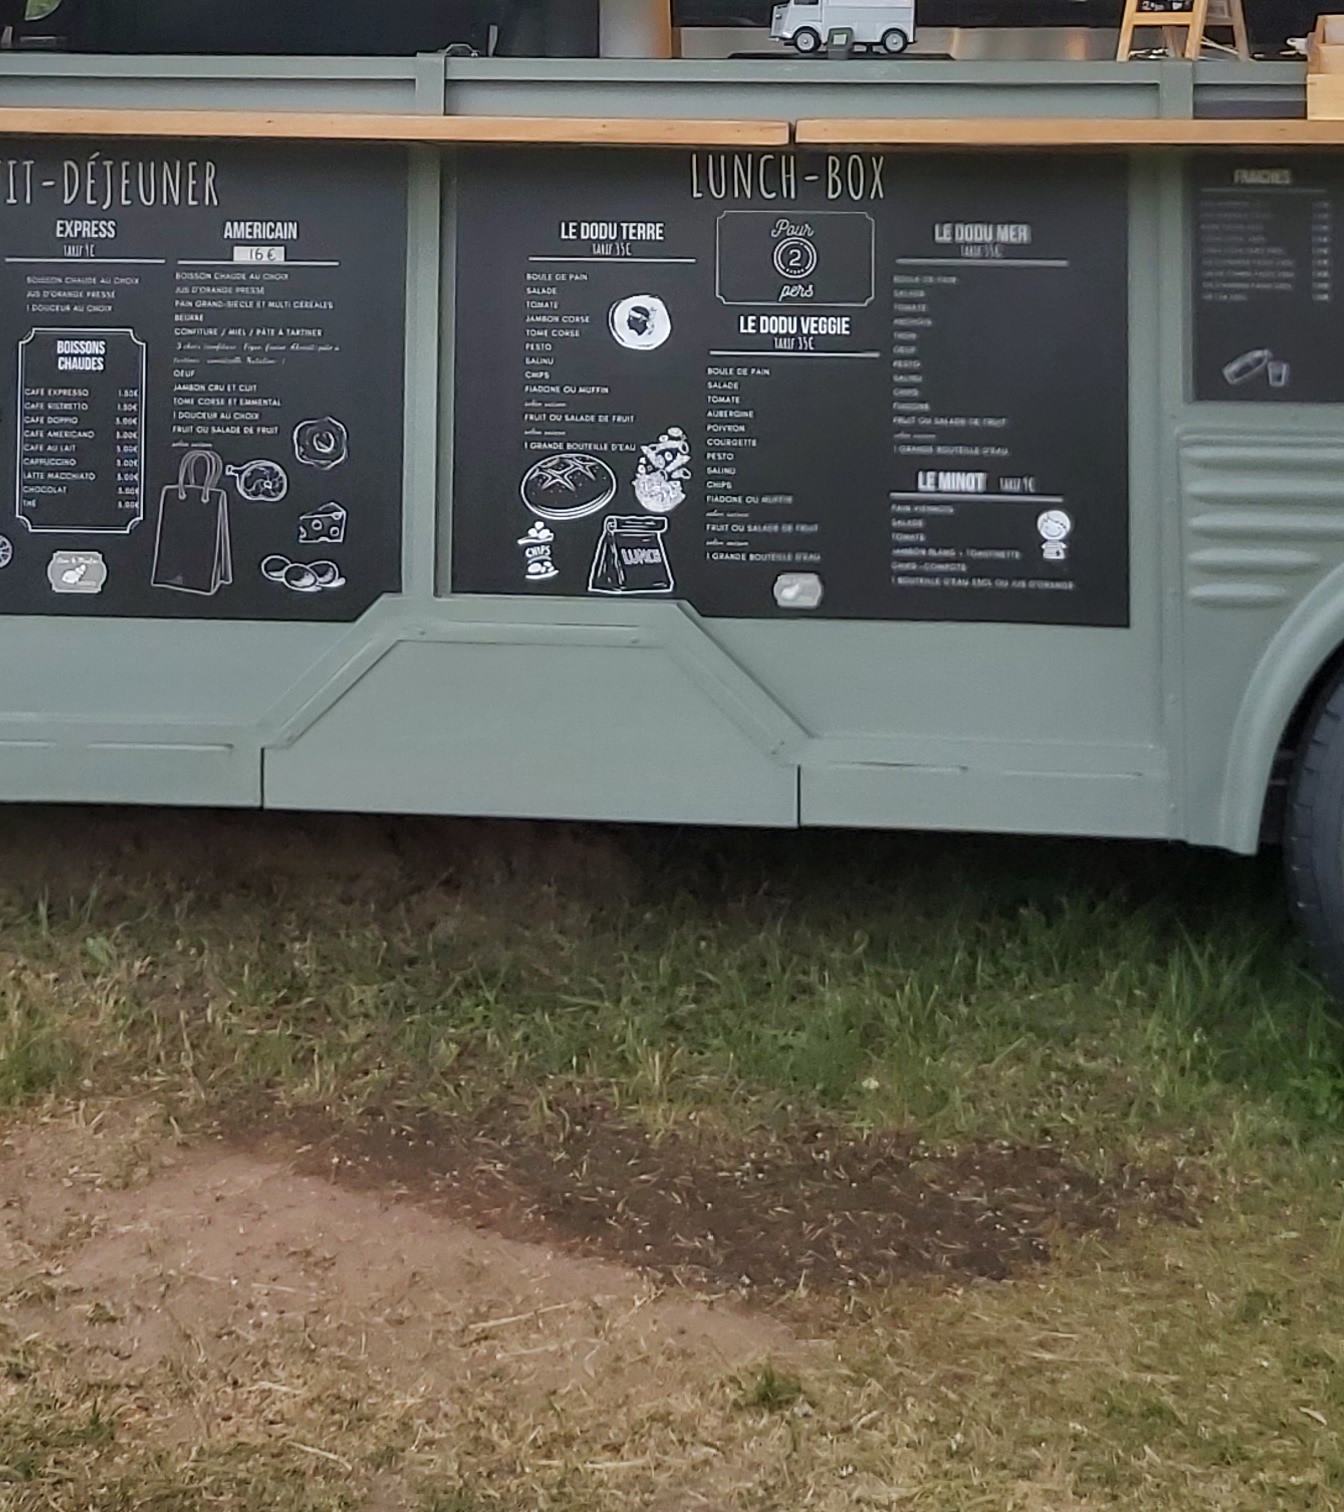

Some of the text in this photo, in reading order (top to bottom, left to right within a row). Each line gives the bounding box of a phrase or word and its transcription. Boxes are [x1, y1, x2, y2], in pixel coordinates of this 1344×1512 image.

[692, 153, 884, 201] LUNCH-BOX
[56, 220, 116, 238] EXPRESS
[224, 221, 298, 239] AMERICAIN
[561, 222, 664, 240] LE DODU TERRE
[771, 219, 814, 238] Pour
[935, 223, 1032, 243] LE DODU MER
[788, 249, 802, 267] 2
[779, 284, 814, 302] pers
[740, 316, 850, 334] LE DODU VEGGIE
[57, 340, 106, 354] BOISSONS
[58, 356, 104, 370] CHAUDES
[918, 471, 936, 491] LE
[939, 472, 986, 492] MINOT
